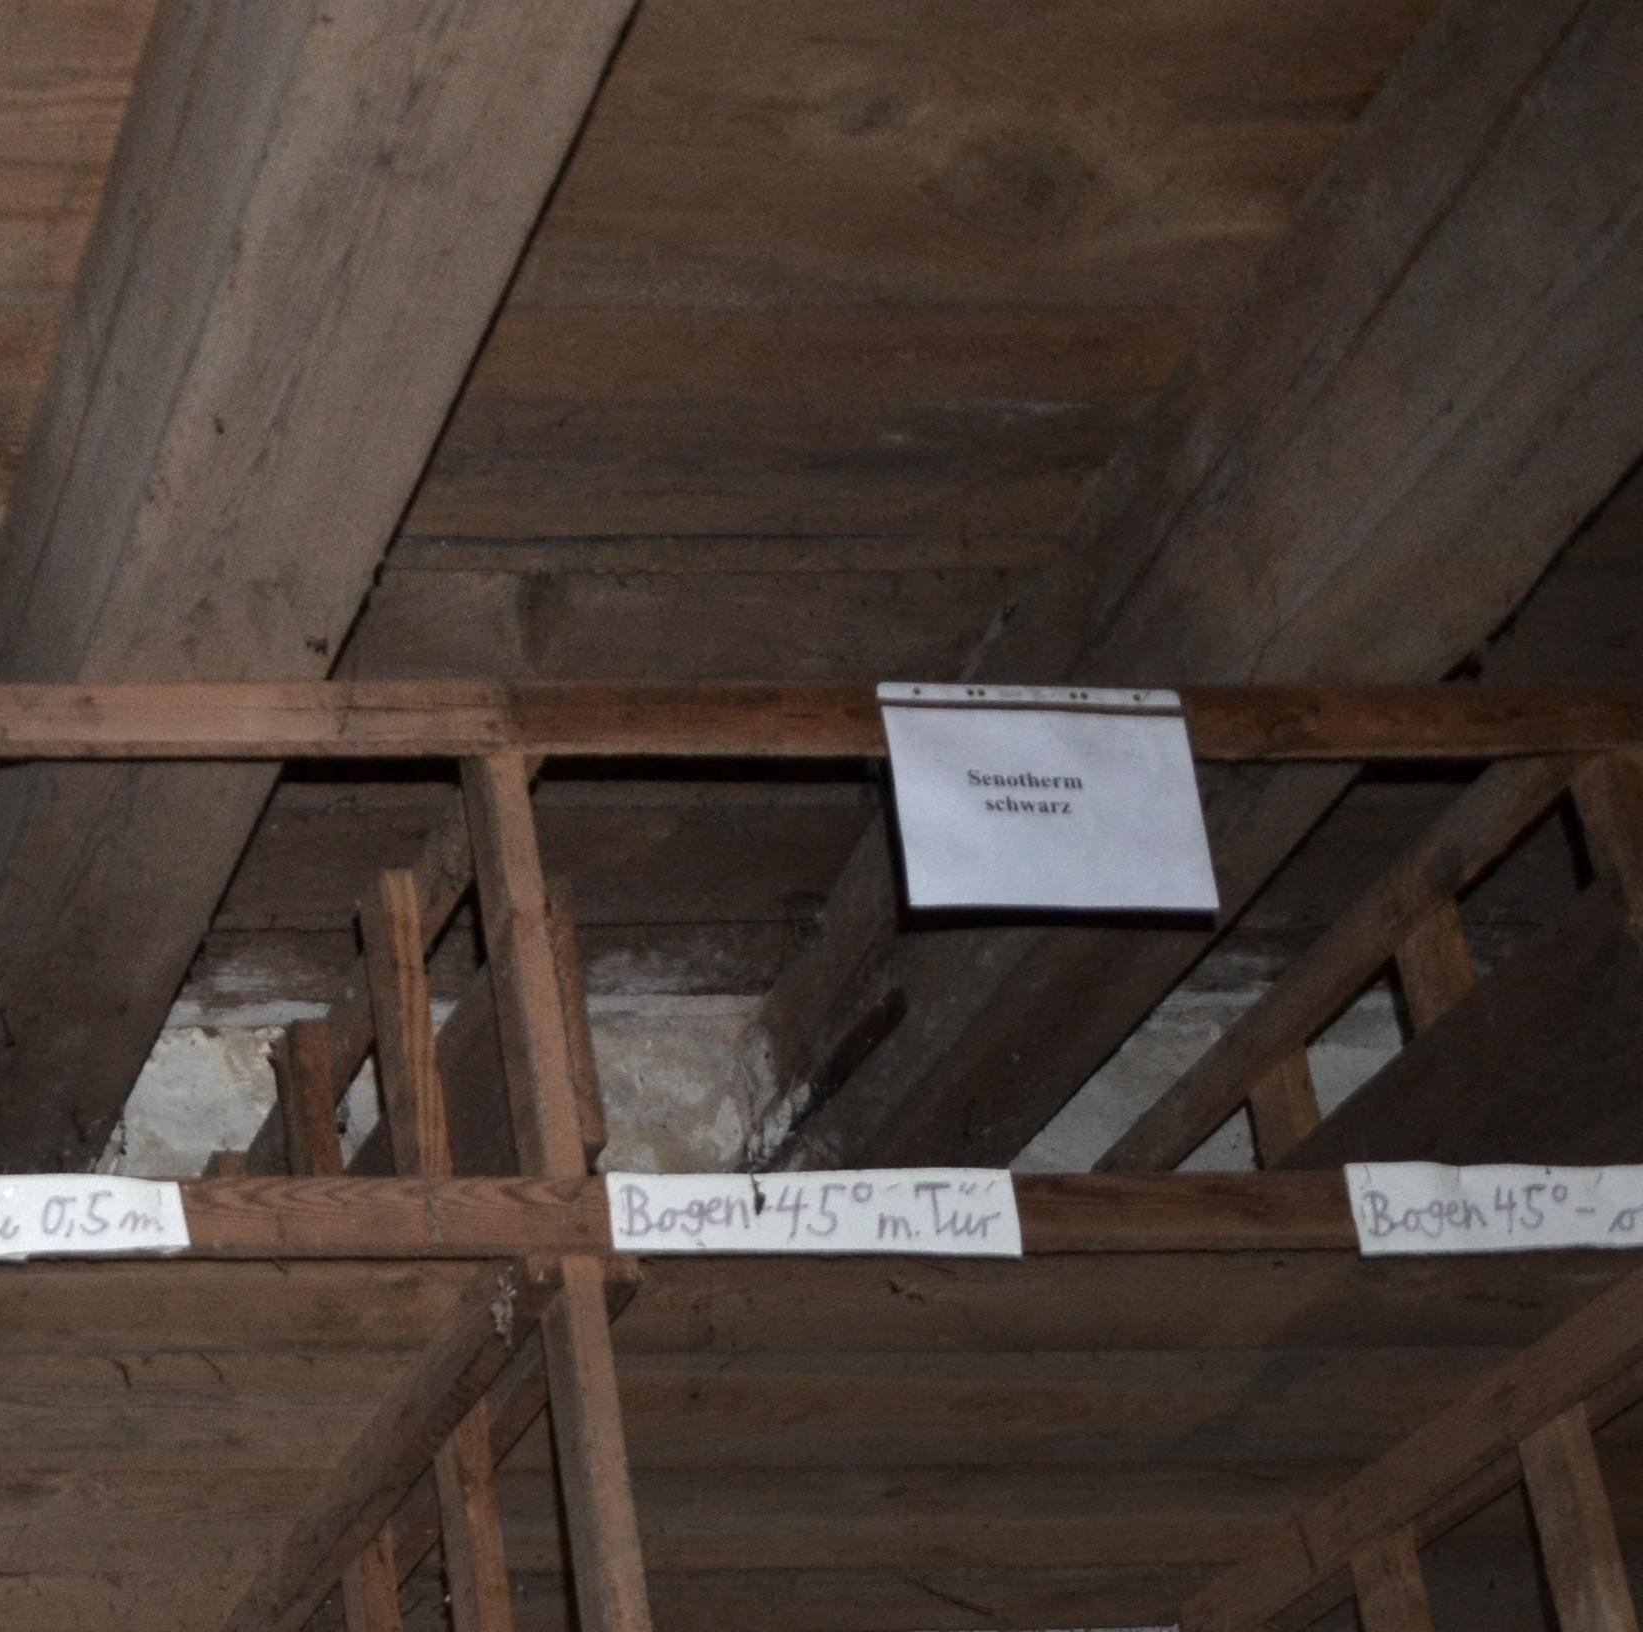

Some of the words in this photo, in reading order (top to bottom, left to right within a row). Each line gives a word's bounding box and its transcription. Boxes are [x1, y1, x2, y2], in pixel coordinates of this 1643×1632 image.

[967, 768, 1084, 791] Senotherm
[984, 797, 1072, 816] schwarz
[1362, 1189, 1488, 1239] Bogen
